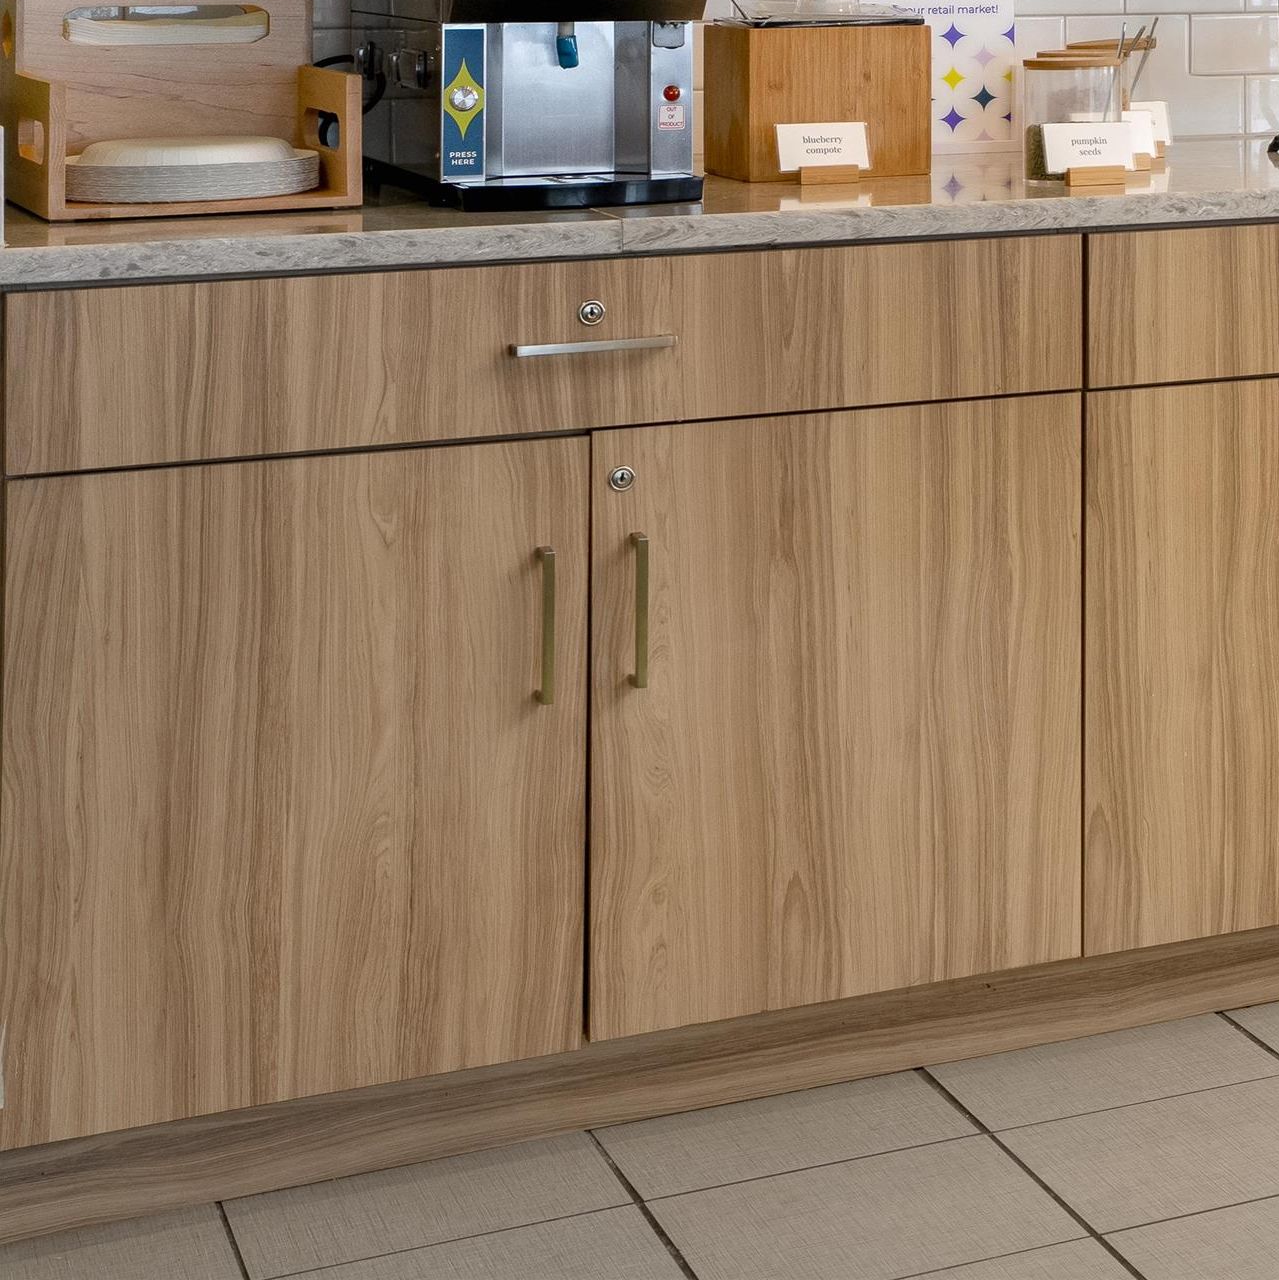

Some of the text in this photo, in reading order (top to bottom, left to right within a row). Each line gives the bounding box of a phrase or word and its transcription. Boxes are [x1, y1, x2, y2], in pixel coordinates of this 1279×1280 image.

[927, 5, 955, 15] retail
[957, 4, 999, 15] market!
[802, 135, 843, 145] blueberry
[1071, 136, 1108, 146] pumpkin
[449, 150, 477, 158] PRESS
[805, 146, 842, 156] compote
[1079, 148, 1102, 157] seeds
[451, 158, 475, 166] HERE
